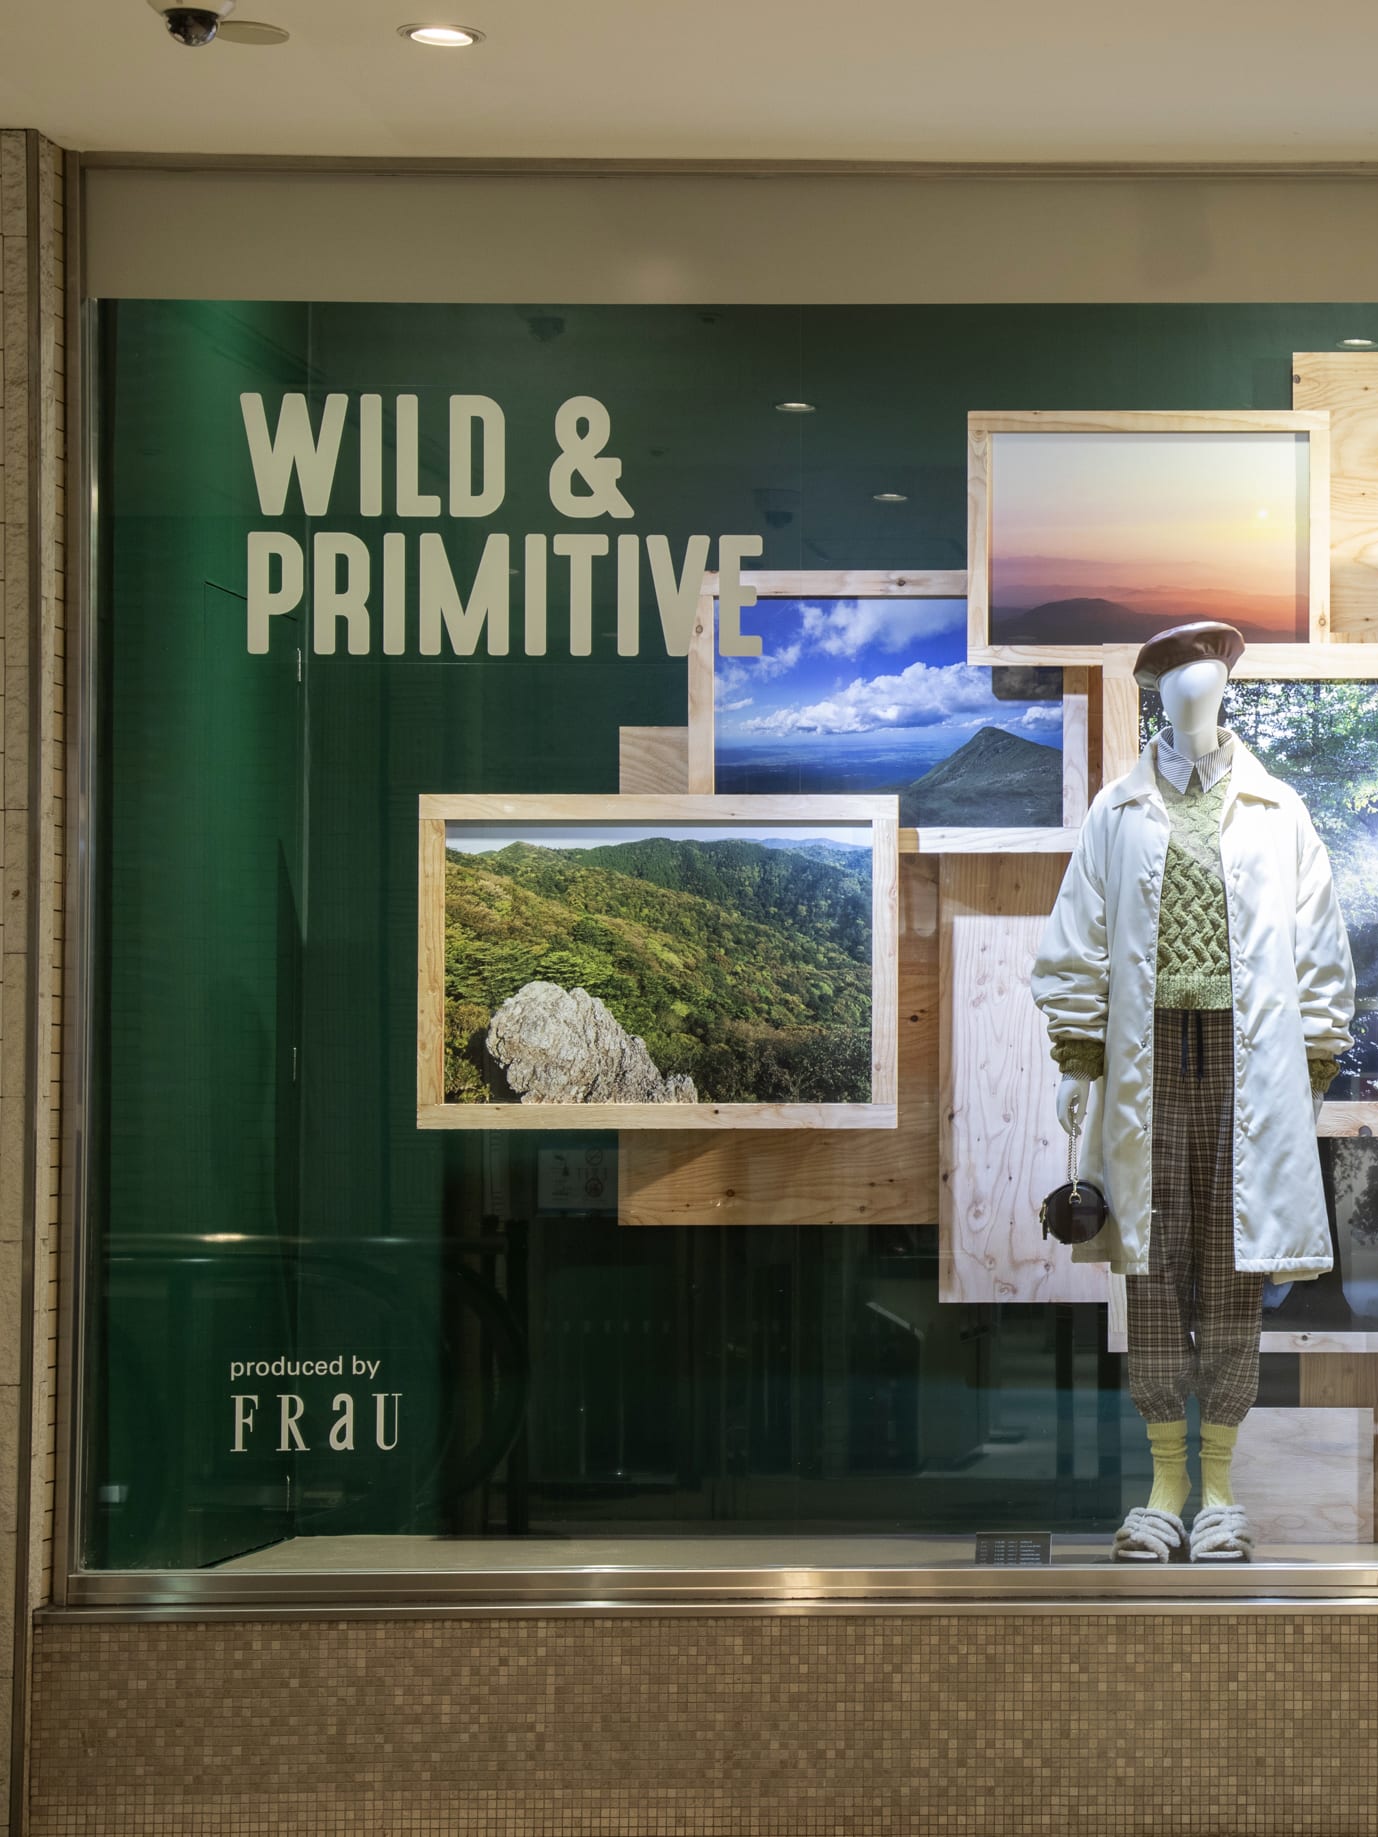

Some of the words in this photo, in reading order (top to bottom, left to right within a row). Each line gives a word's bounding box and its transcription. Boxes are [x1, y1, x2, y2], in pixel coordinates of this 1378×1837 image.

[240, 392, 506, 517] WILD
[549, 395, 635, 518] &
[247, 531, 763, 657] PRIMITIVE
[230, 1355, 343, 1381] produced
[352, 1355, 381, 1380] by
[230, 1393, 403, 1452] FRaU
